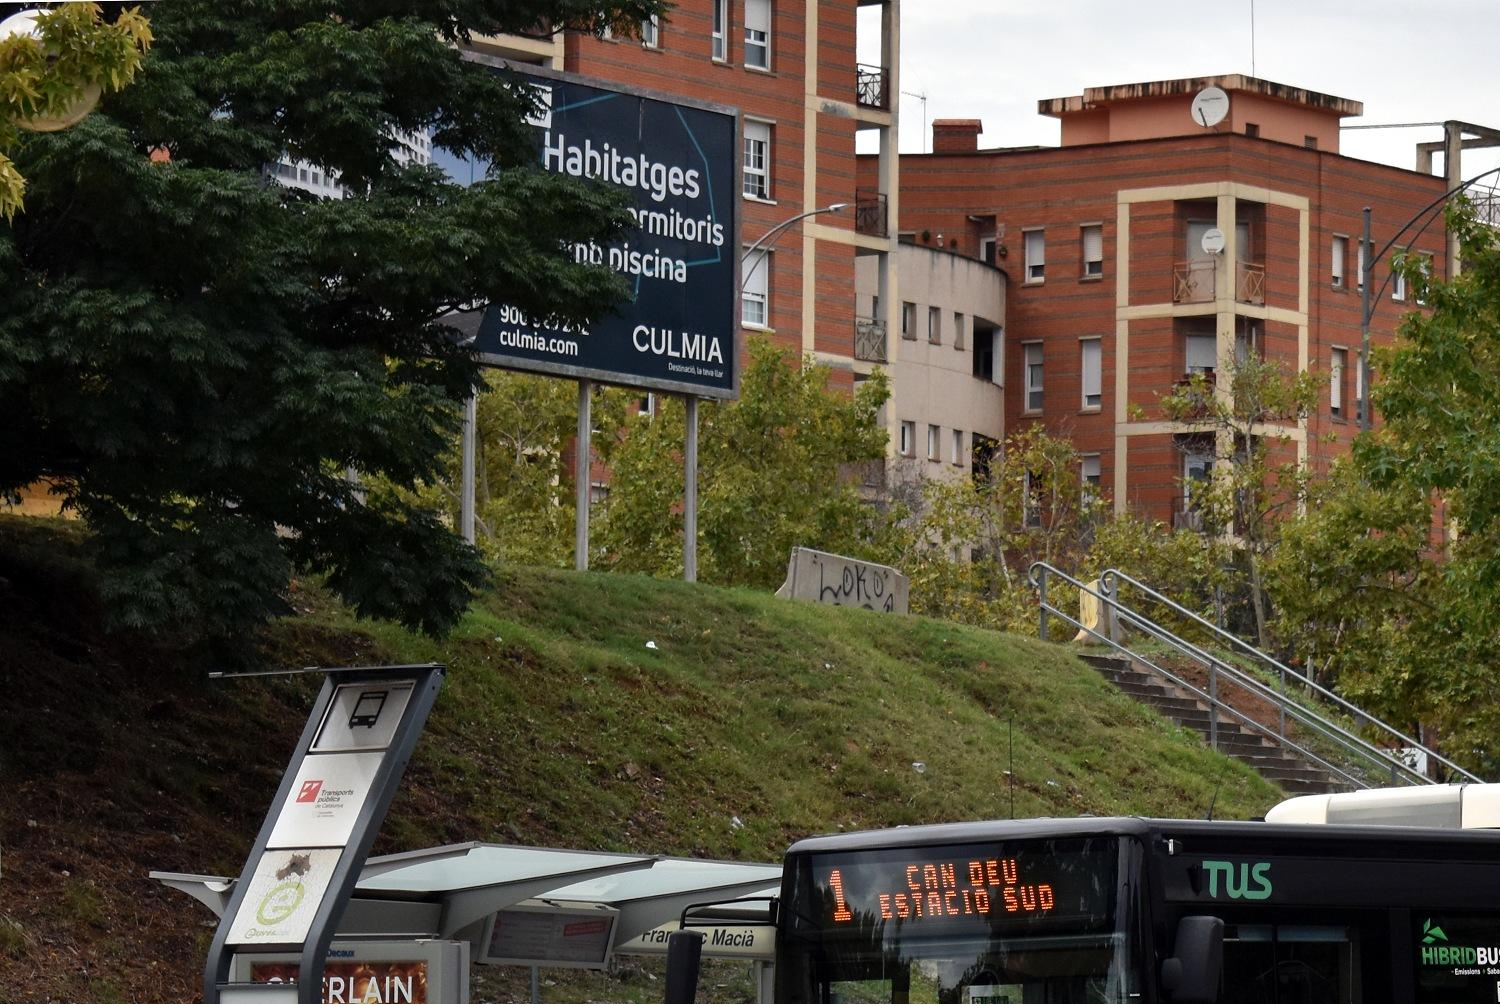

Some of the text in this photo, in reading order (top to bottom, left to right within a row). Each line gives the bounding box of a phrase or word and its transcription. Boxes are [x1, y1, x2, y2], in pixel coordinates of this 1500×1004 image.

[544, 131, 700, 202] Habitatges
[500, 325, 724, 364] culmia.com CULMIA
[321, 789, 354, 797] Transports
[829, 858, 1017, 921] 1 CAN DEU
[1202, 860, 1273, 900] TUS
[879, 885, 1054, 919] ESTACIO SUD
[641, 929, 754, 948] Franc Macià
